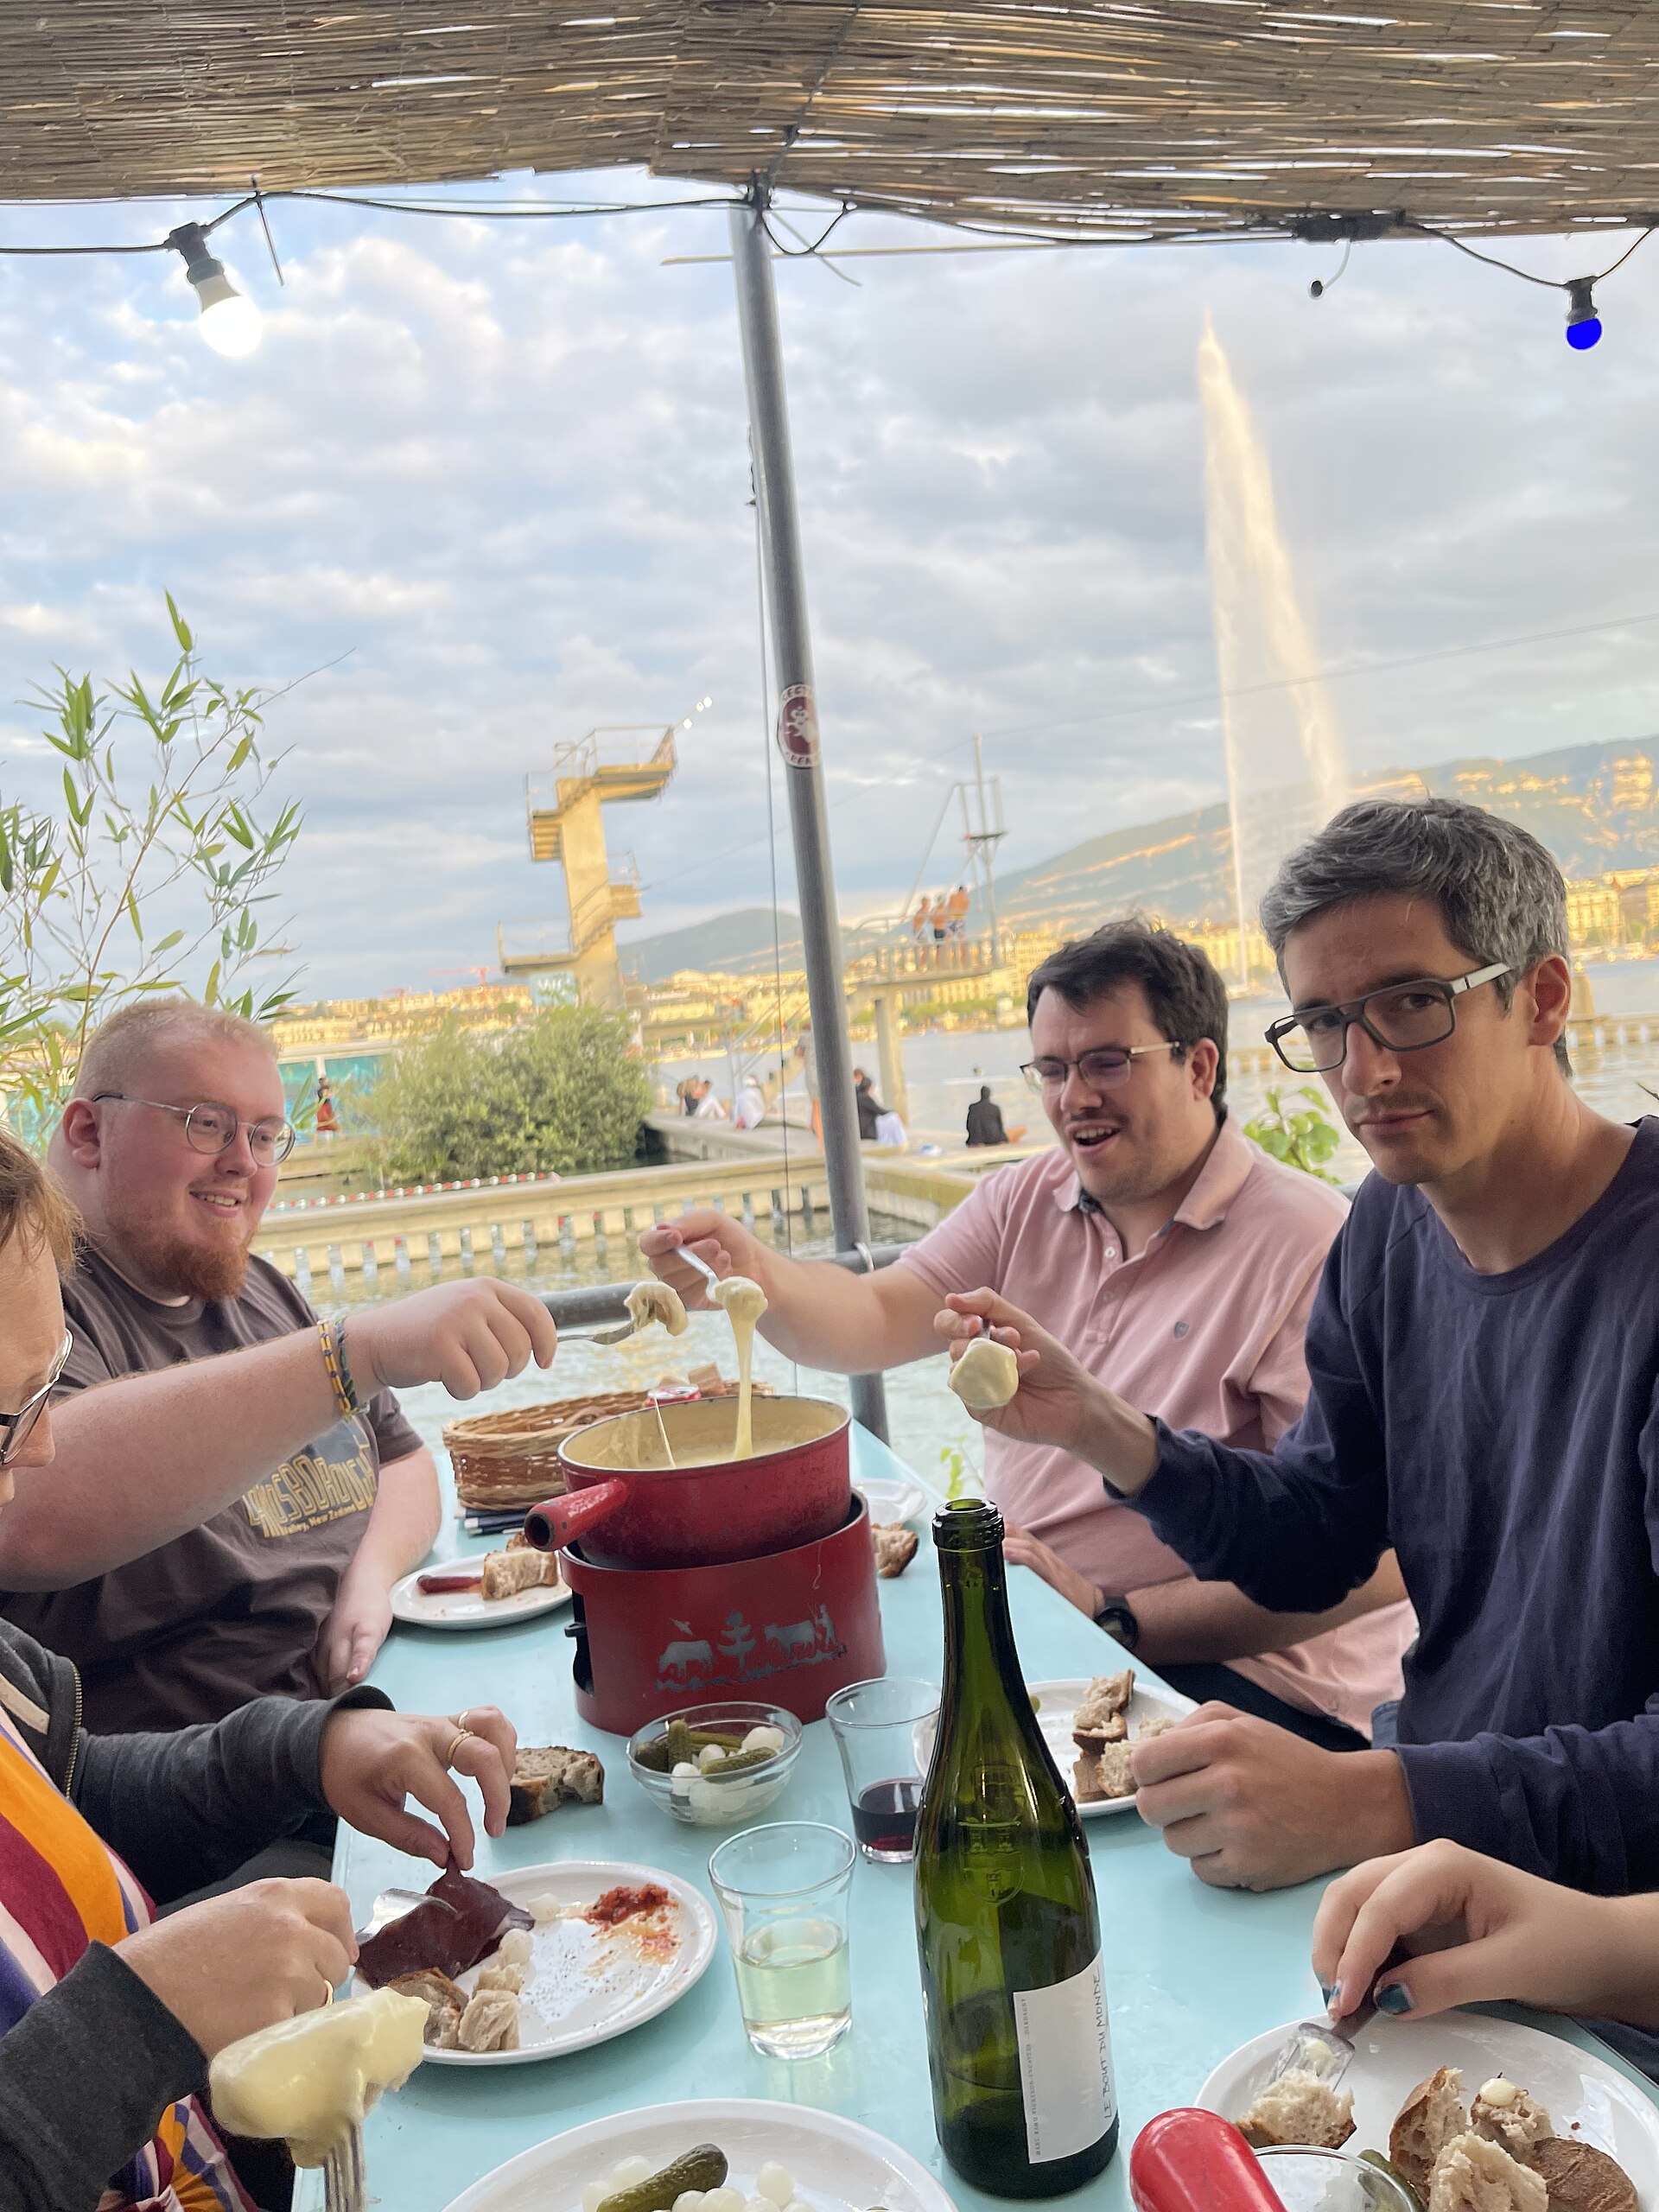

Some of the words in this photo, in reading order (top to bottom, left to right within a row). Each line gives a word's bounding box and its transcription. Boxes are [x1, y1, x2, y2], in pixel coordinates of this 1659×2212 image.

[308, 1514, 328, 1527] New
[327, 1504, 357, 1521] Zealand
[1093, 1964, 1105, 2027] MONDE
[1098, 2031, 1107, 2054] DU
[1100, 2056, 1110, 2098] BOUT
[1103, 2100, 1112, 2119] LE
